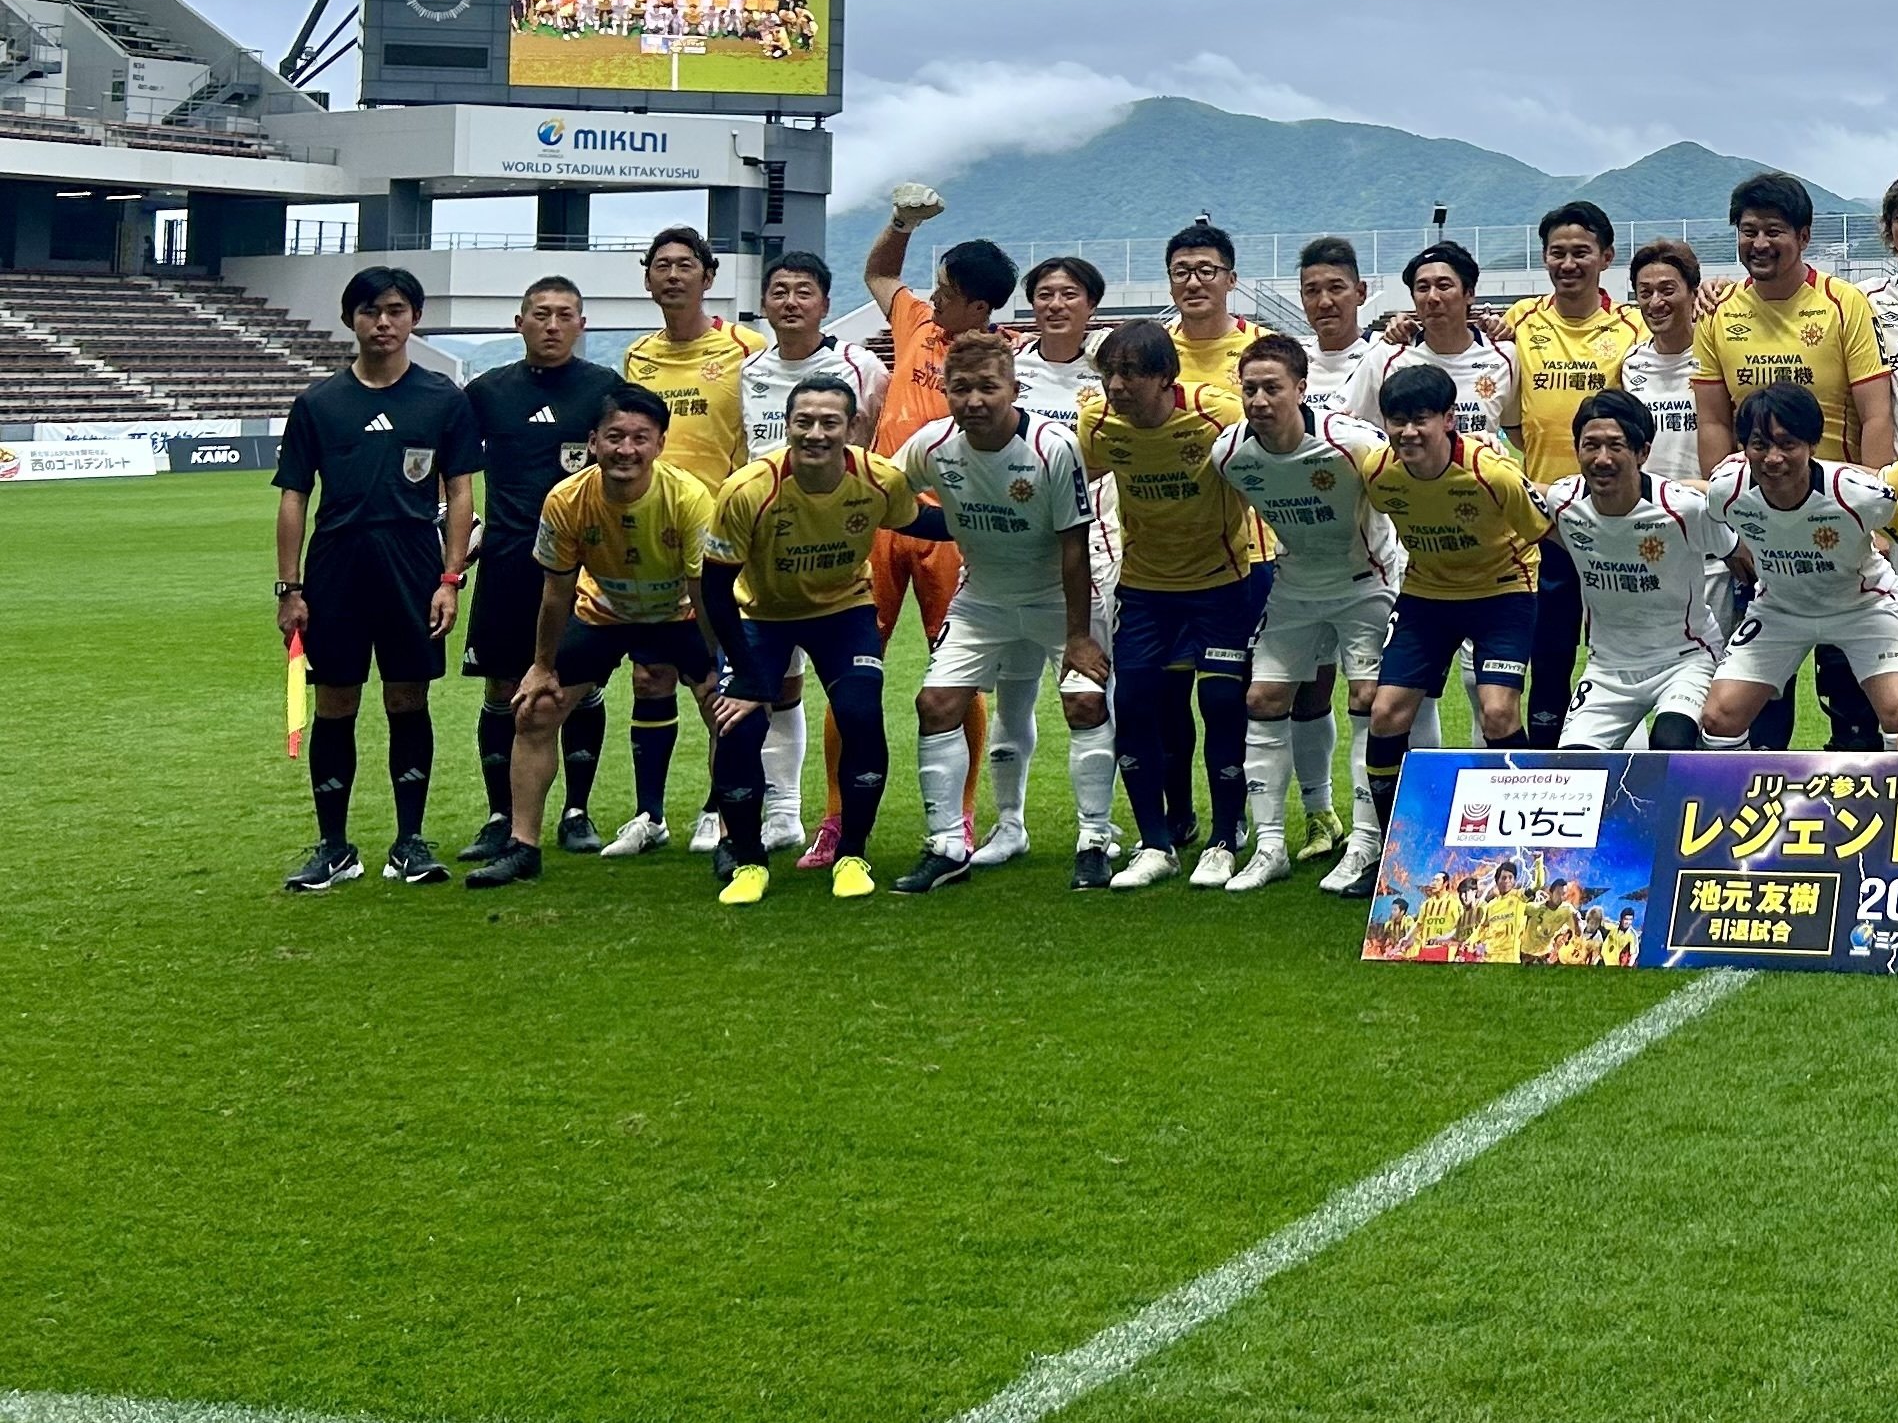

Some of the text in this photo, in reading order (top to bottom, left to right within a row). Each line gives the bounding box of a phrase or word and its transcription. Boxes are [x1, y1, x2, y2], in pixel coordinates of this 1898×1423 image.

[573, 128, 667, 153] MIKUNI
[502, 161, 700, 179] WORLD STADIUM KITAKYUSHU
[1541, 360, 1598, 370] YASKAWA
[1744, 354, 1803, 365] YASKAWA
[1533, 372, 1607, 391] 安川電機
[1736, 367, 1814, 386] 安川電機
[191, 449, 240, 465] KAMO
[31, 458, 131, 472] 西のゴールデンルート
[1130, 471, 1189, 483] YASKAWA
[960, 502, 1016, 516] YASKAWA
[1264, 496, 1322, 508] YASKAWA
[1408, 525, 1465, 535] YASKAWA
[786, 541, 848, 555] YASKAWA
[1760, 549, 1824, 560] YASKAWA
[1588, 560, 1649, 573] YASKAWA
[1583, 572, 1662, 593] 安川電機
[1490, 774, 1571, 784] supported by
[1503, 791, 1593, 802] サステナブルインフラ
[1499, 807, 1590, 838] いちご
[1709, 919, 1793, 943] 引退試合
